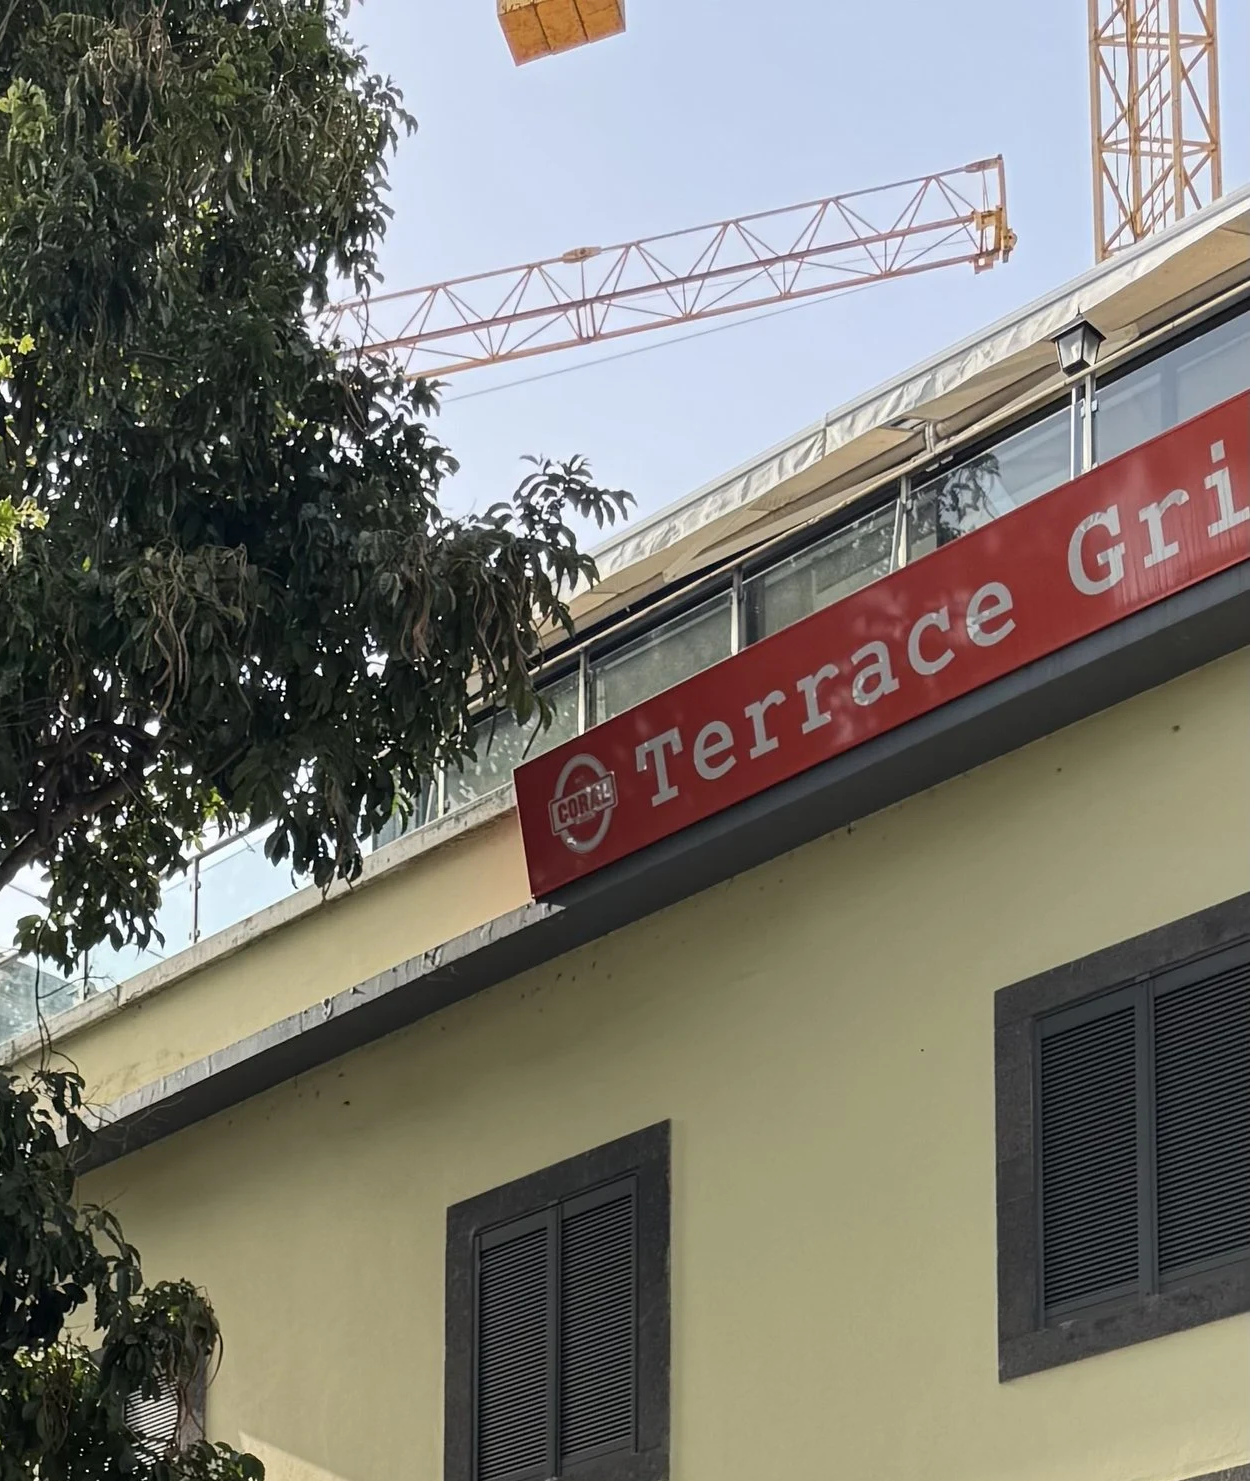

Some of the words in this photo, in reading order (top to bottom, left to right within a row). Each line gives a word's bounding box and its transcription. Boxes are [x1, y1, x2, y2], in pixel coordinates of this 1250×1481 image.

[635, 582, 1016, 807] Terrace
[1068, 440, 1250, 596] Gri
[557, 783, 611, 824] CORAL
